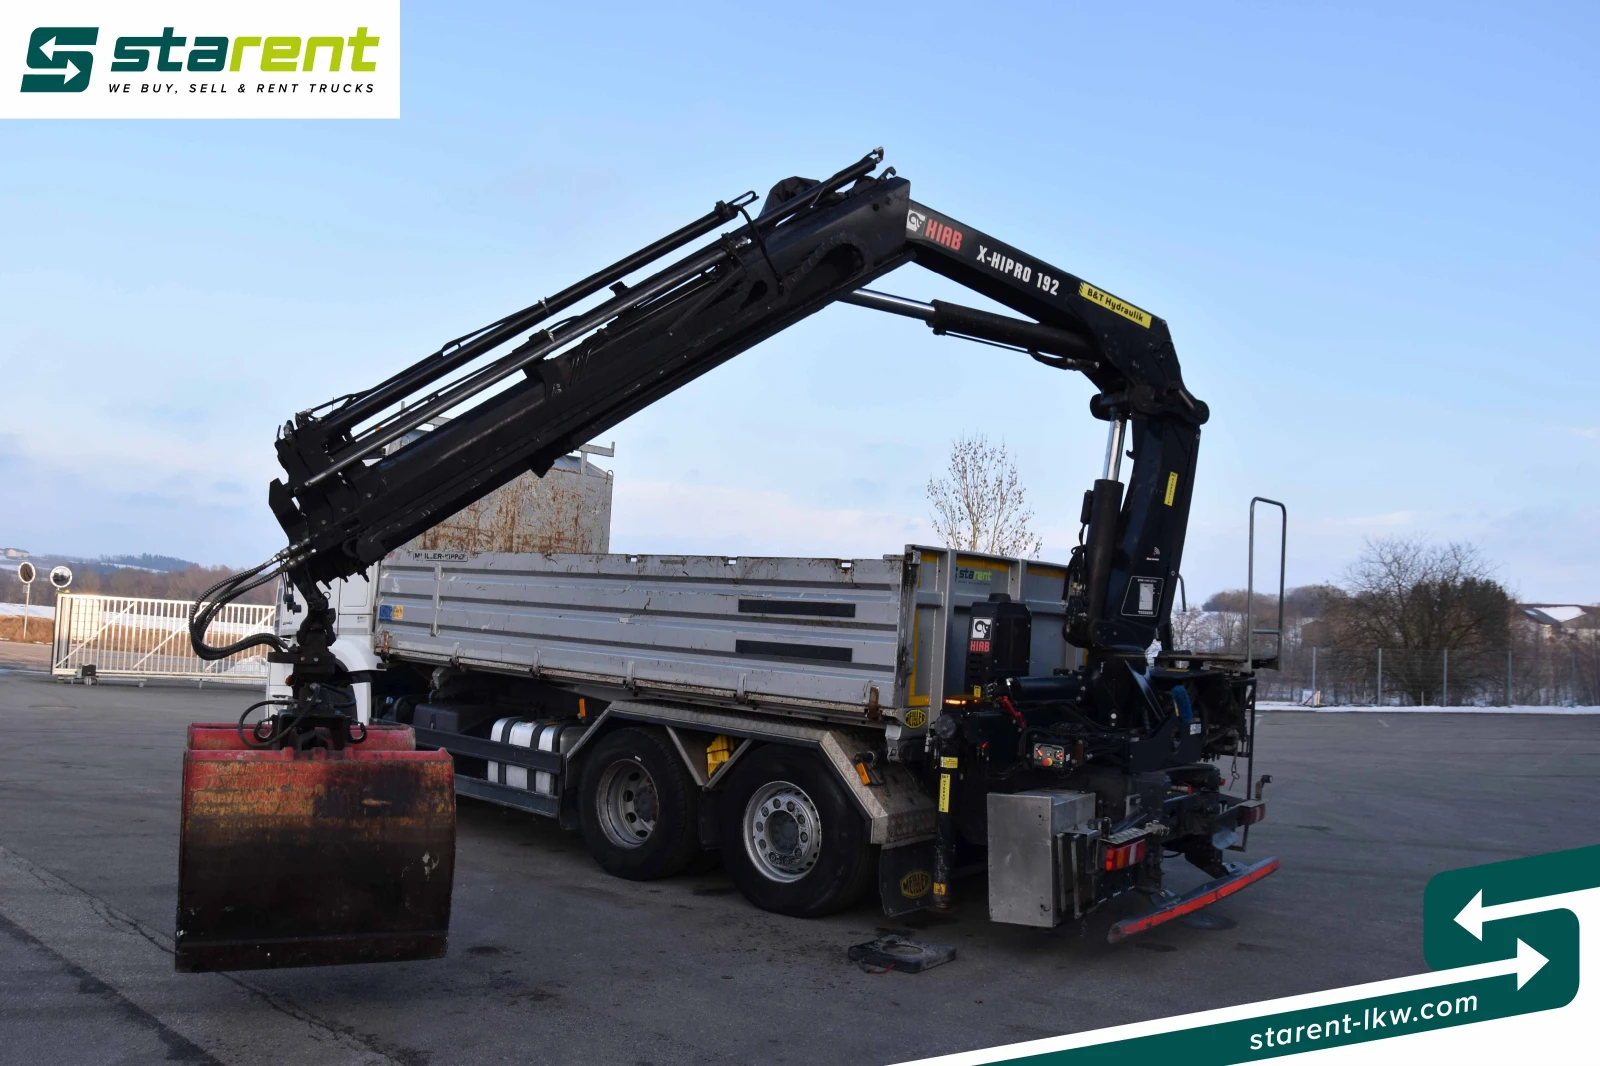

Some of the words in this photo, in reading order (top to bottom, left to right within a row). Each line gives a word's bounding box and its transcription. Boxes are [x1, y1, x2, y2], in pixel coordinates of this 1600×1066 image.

[924, 218, 963, 251] HIAB
[976, 245, 1032, 283] X-HIPRO
[1036, 272, 1060, 296] 192
[1087, 288, 1104, 302] B&T
[1105, 296, 1144, 322] Hydraulik
[959, 568, 993, 582] starent
[970, 641, 991, 653] HIAB
